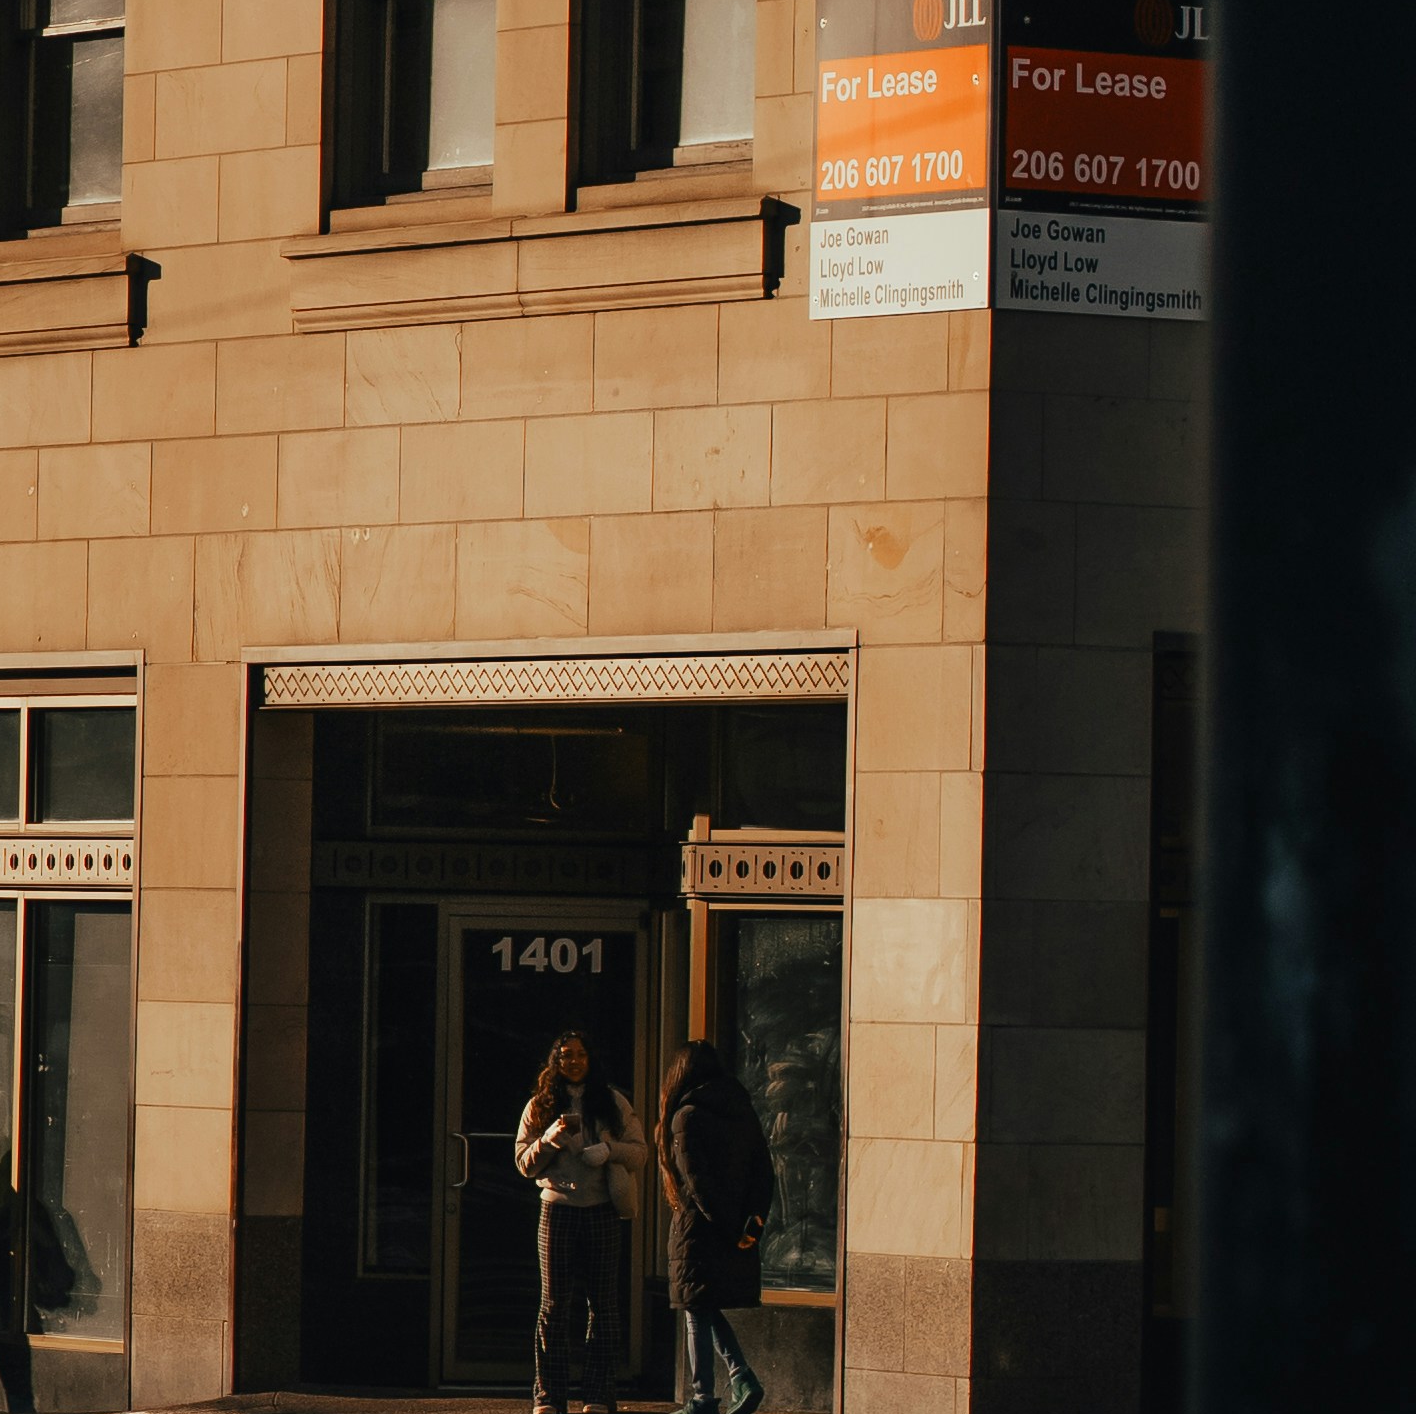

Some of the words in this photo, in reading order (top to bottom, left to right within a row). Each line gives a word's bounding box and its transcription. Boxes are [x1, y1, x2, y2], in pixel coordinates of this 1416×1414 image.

[1174, 5, 1210, 40] JL
[822, 71, 861, 103] For
[867, 67, 938, 99] Lease
[1011, 58, 1066, 91] For
[1076, 62, 1167, 99] Lease
[821, 160, 859, 190] 206
[865, 155, 903, 186] 607
[911, 150, 963, 182] 1700
[1012, 149, 1064, 181] 206
[1074, 153, 1125, 185] 607
[1136, 158, 1200, 191] 1700
[819, 229, 842, 249] Joe
[845, 227, 889, 247] Gowan
[1010, 218, 1041, 239] Joe
[1047, 220, 1106, 243] Gowan
[819, 258, 854, 280] Lloyd
[858, 257, 884, 276] Low
[1010, 248, 1058, 275] Lloyd
[1064, 252, 1099, 273] Low
[819, 286, 870, 309] Michelle
[874, 281, 964, 308] Clingingsmith
[1010, 279, 1080, 303] Michelle
[1086, 283, 1202, 312] Clingingsmith
[492, 936, 602, 974] 1401
